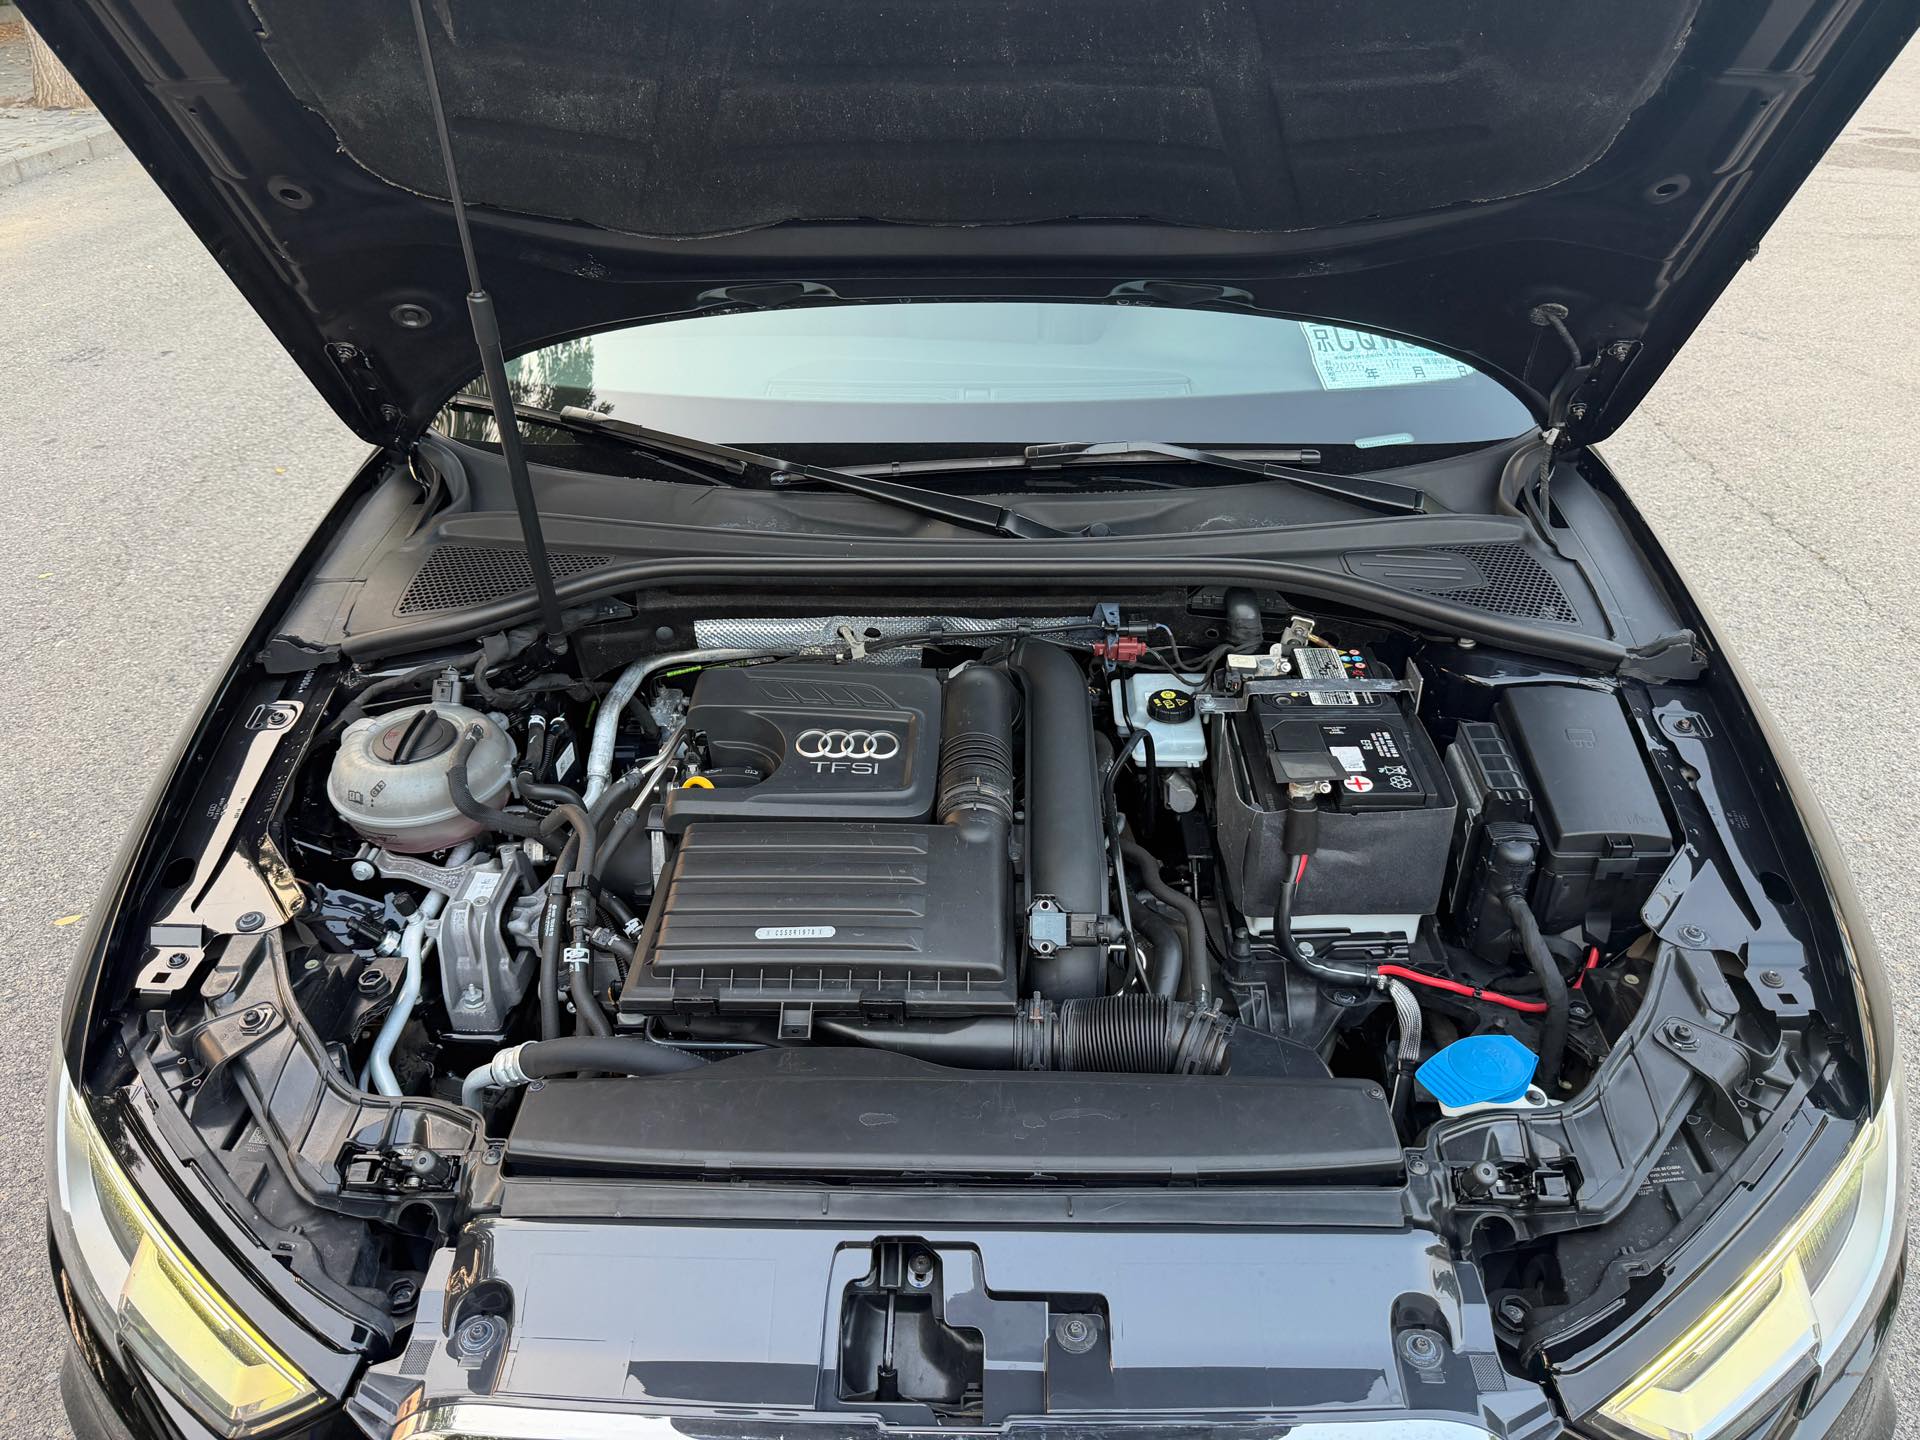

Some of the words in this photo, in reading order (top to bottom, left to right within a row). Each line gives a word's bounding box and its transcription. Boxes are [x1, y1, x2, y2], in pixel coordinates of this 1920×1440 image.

[1365, 367, 1380, 379] 年
[1412, 366, 1426, 378] 月
[1457, 365, 1468, 378] 日
[809, 761, 879, 775] TFSI
